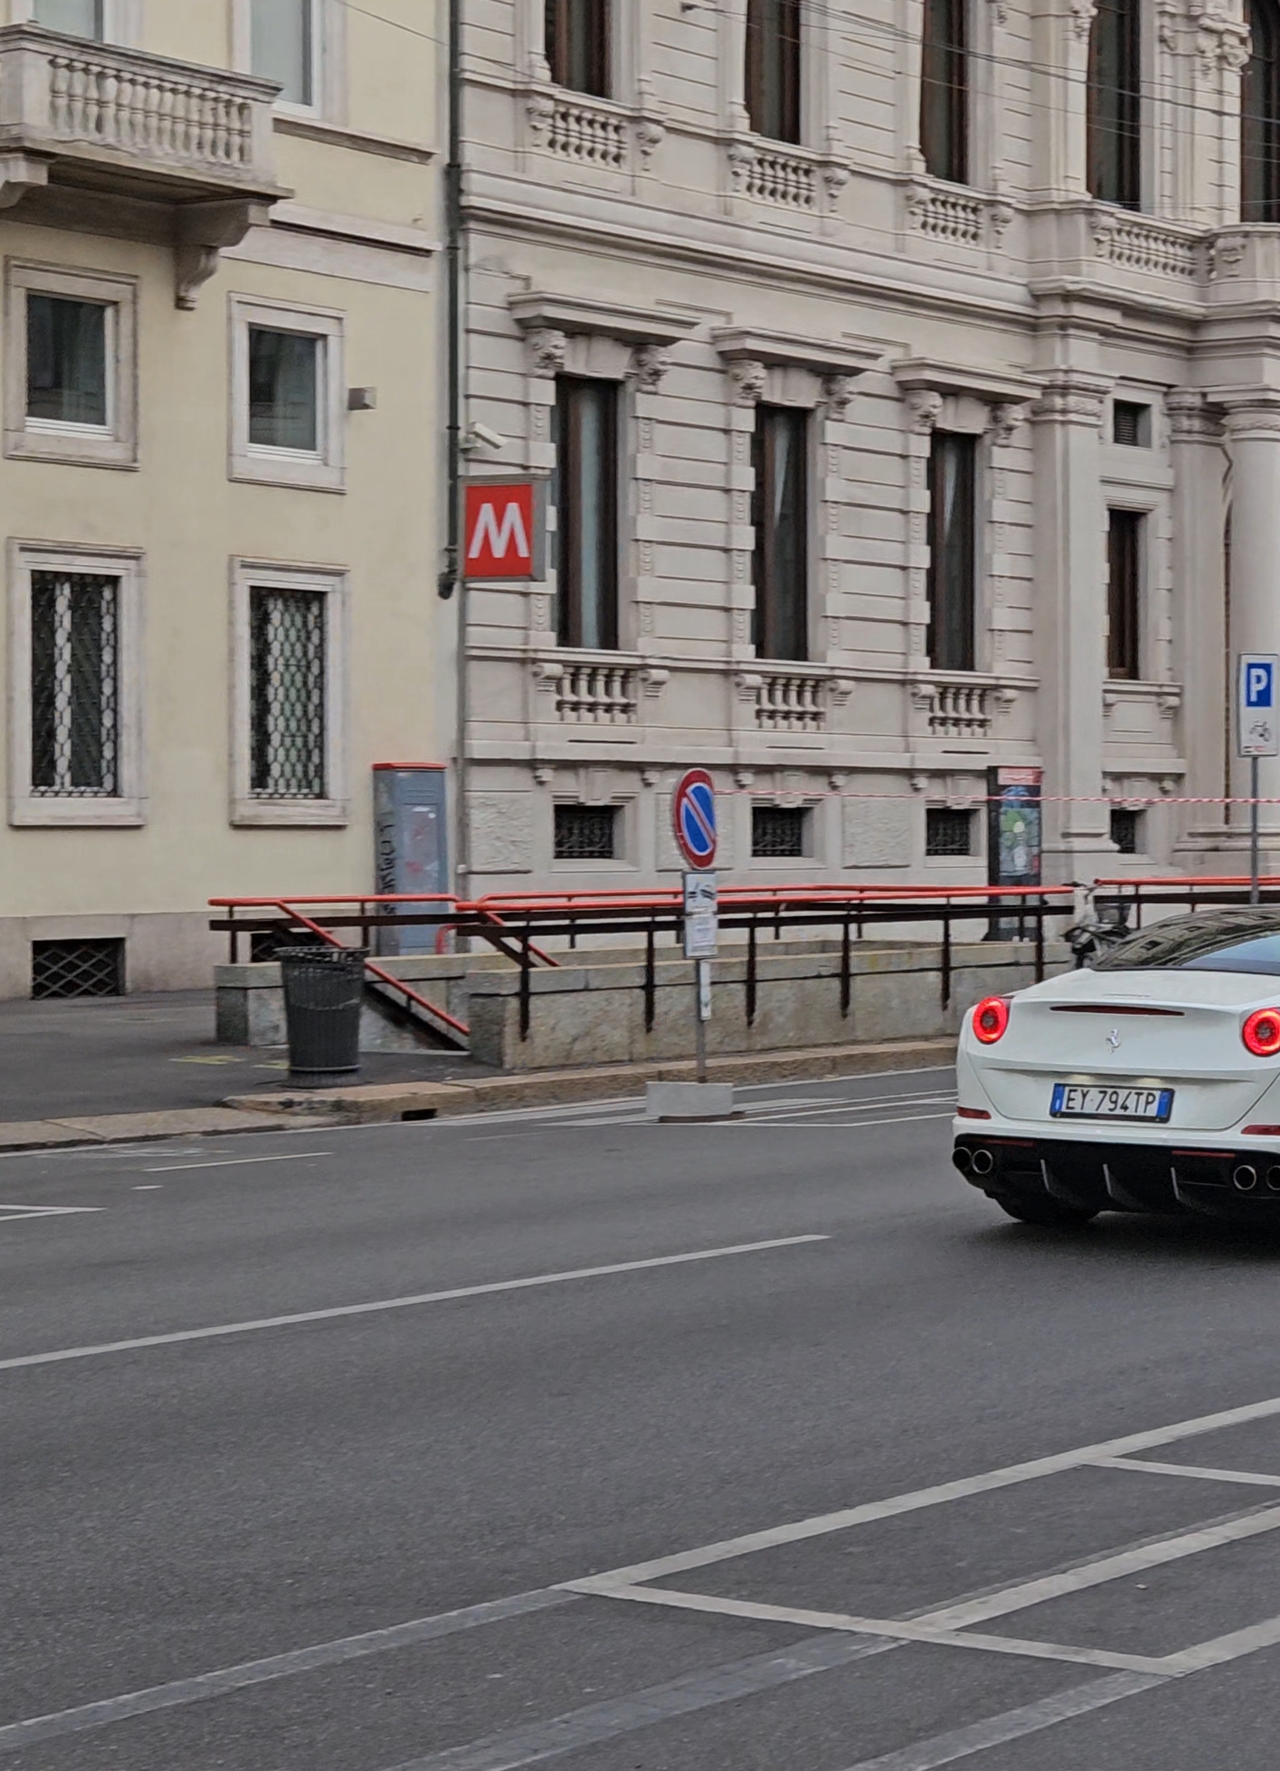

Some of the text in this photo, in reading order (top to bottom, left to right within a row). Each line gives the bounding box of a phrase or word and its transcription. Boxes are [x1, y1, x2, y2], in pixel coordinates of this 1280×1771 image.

[468, 502, 530, 558] M
[1249, 668, 1268, 702] P
[1065, 1089, 1156, 1113] EY 794TP
